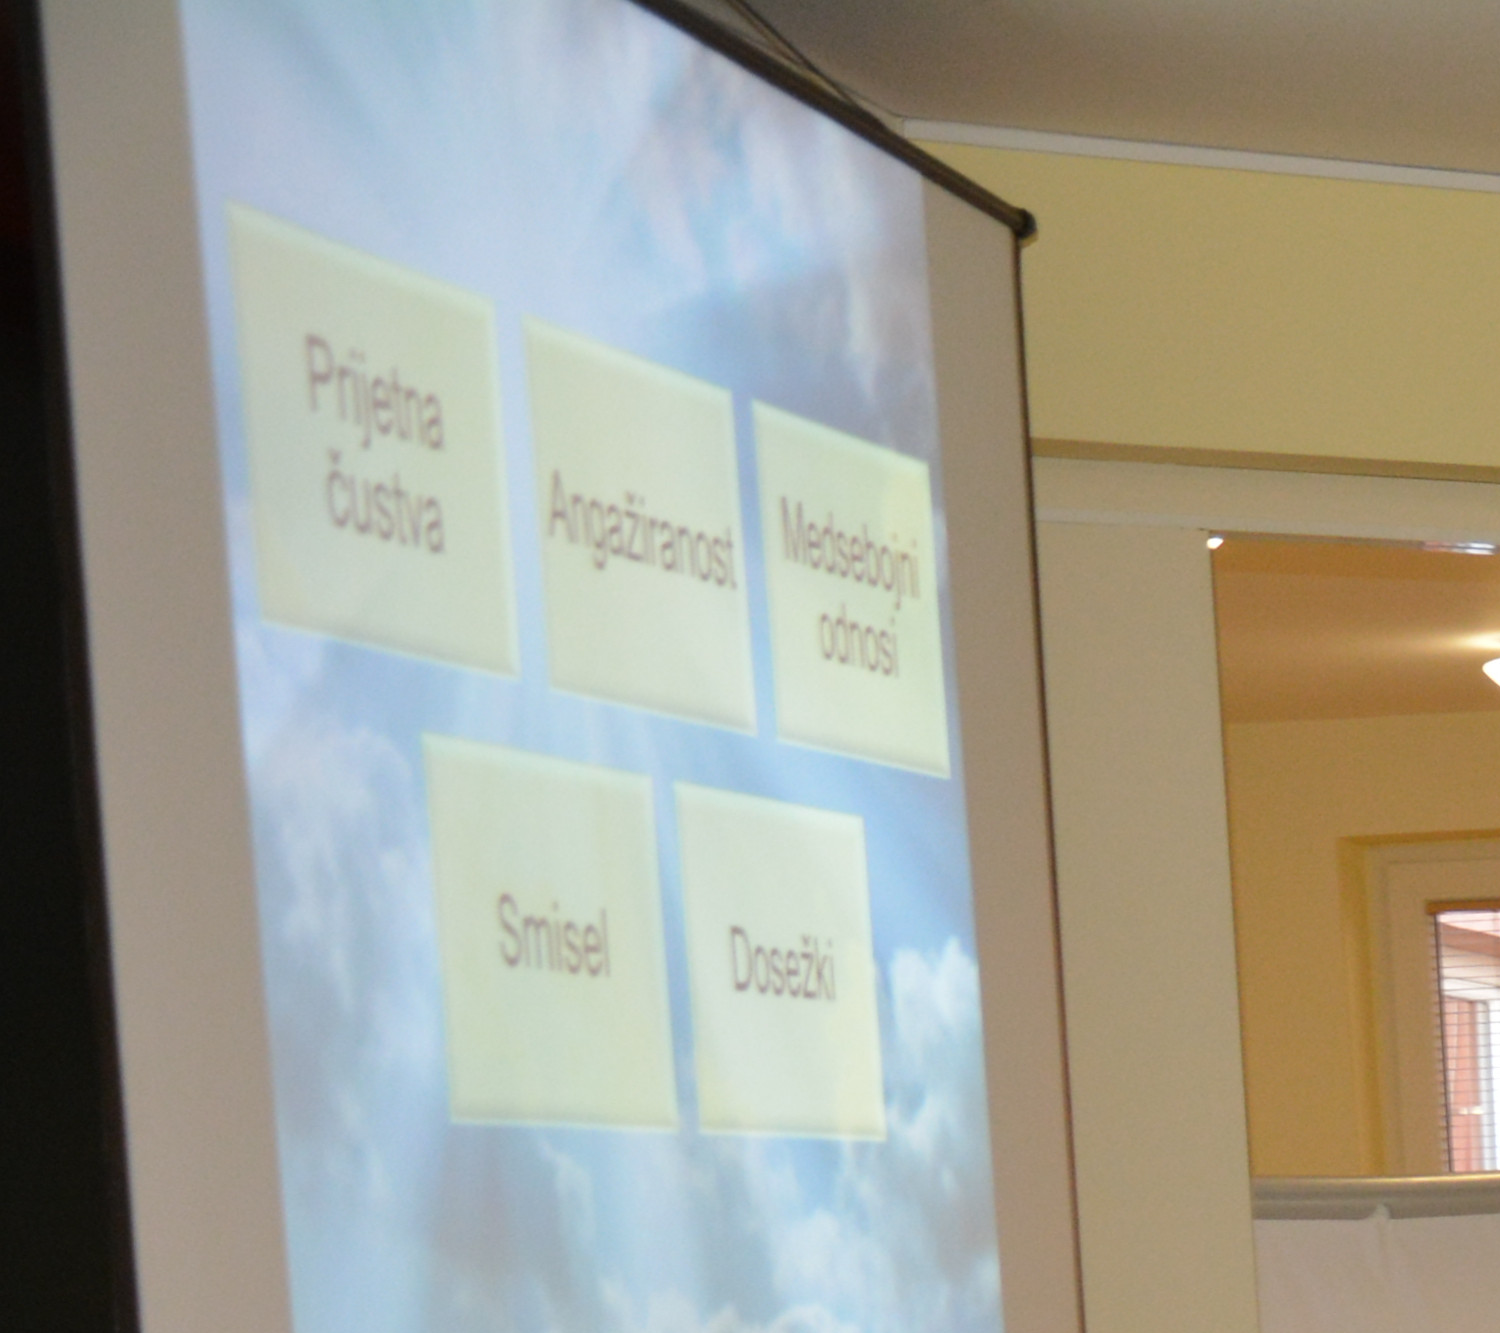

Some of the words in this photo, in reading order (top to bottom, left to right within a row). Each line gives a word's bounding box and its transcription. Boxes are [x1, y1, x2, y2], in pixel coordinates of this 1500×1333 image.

[305, 333, 444, 449] Prijetna
[325, 449, 444, 554] čustva
[547, 468, 738, 591] Angažiranost
[779, 495, 921, 612] Medsebojni
[818, 602, 899, 679] odnosi
[497, 892, 612, 979] Smisel
[729, 924, 837, 1002] Dosežki
